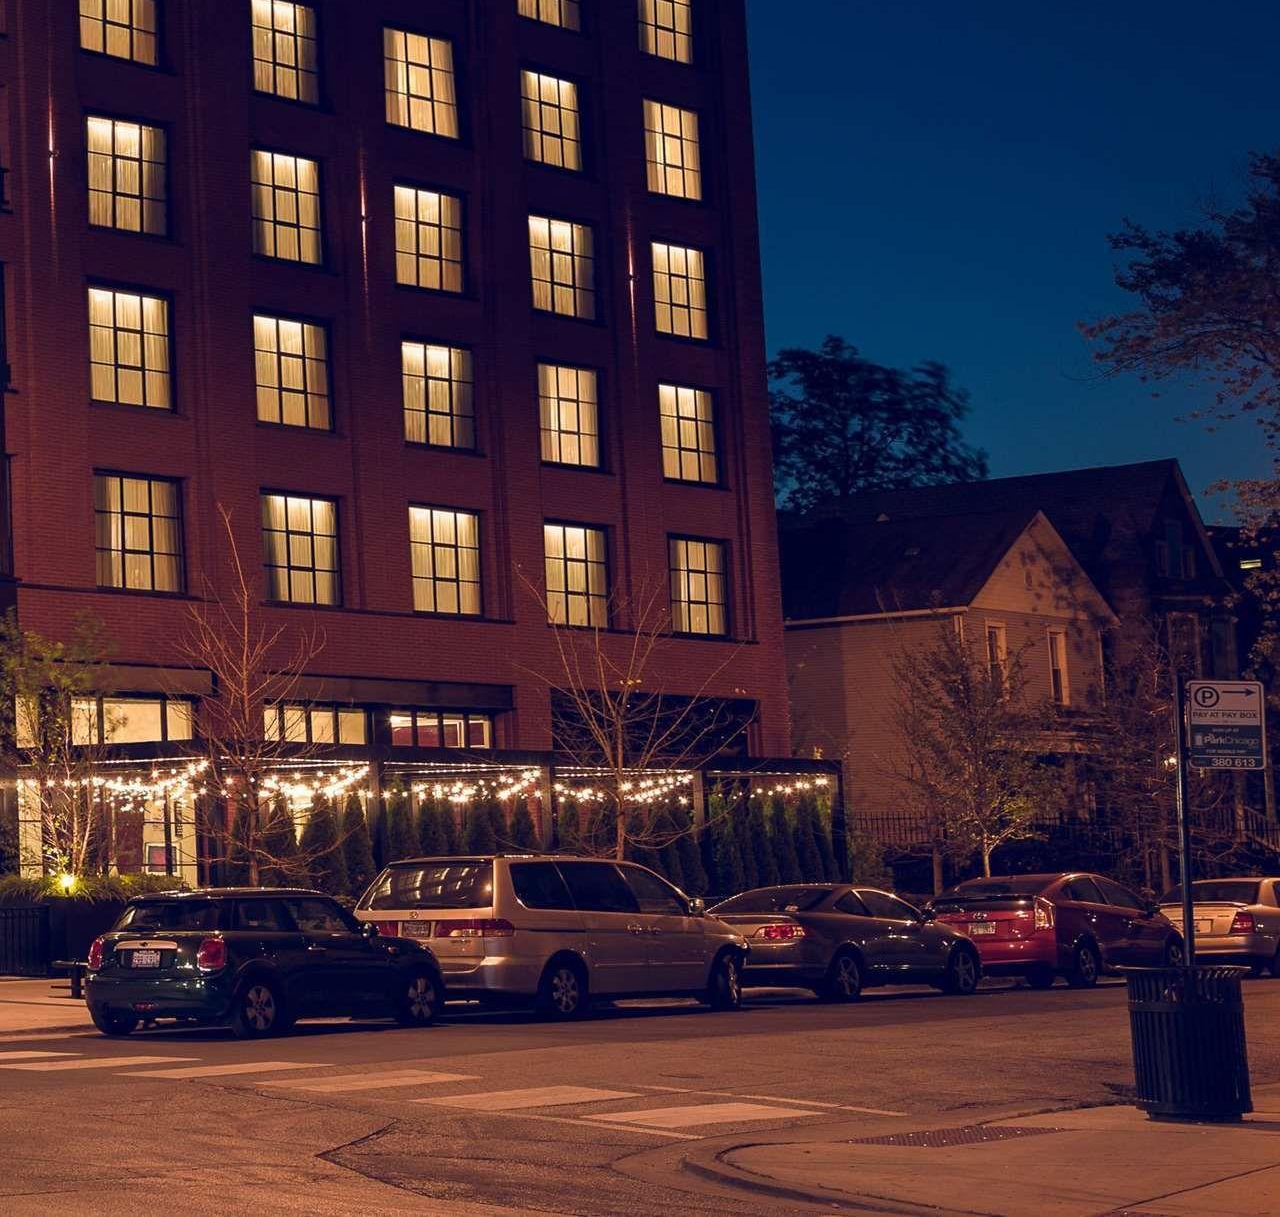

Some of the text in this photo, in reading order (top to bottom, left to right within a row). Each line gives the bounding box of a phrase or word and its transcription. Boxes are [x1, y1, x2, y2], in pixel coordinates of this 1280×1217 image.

[1193, 711, 1257, 719] PAY AT PAY BOX
[1211, 758, 1233, 767] 380
[1235, 758, 1256, 767] 613
